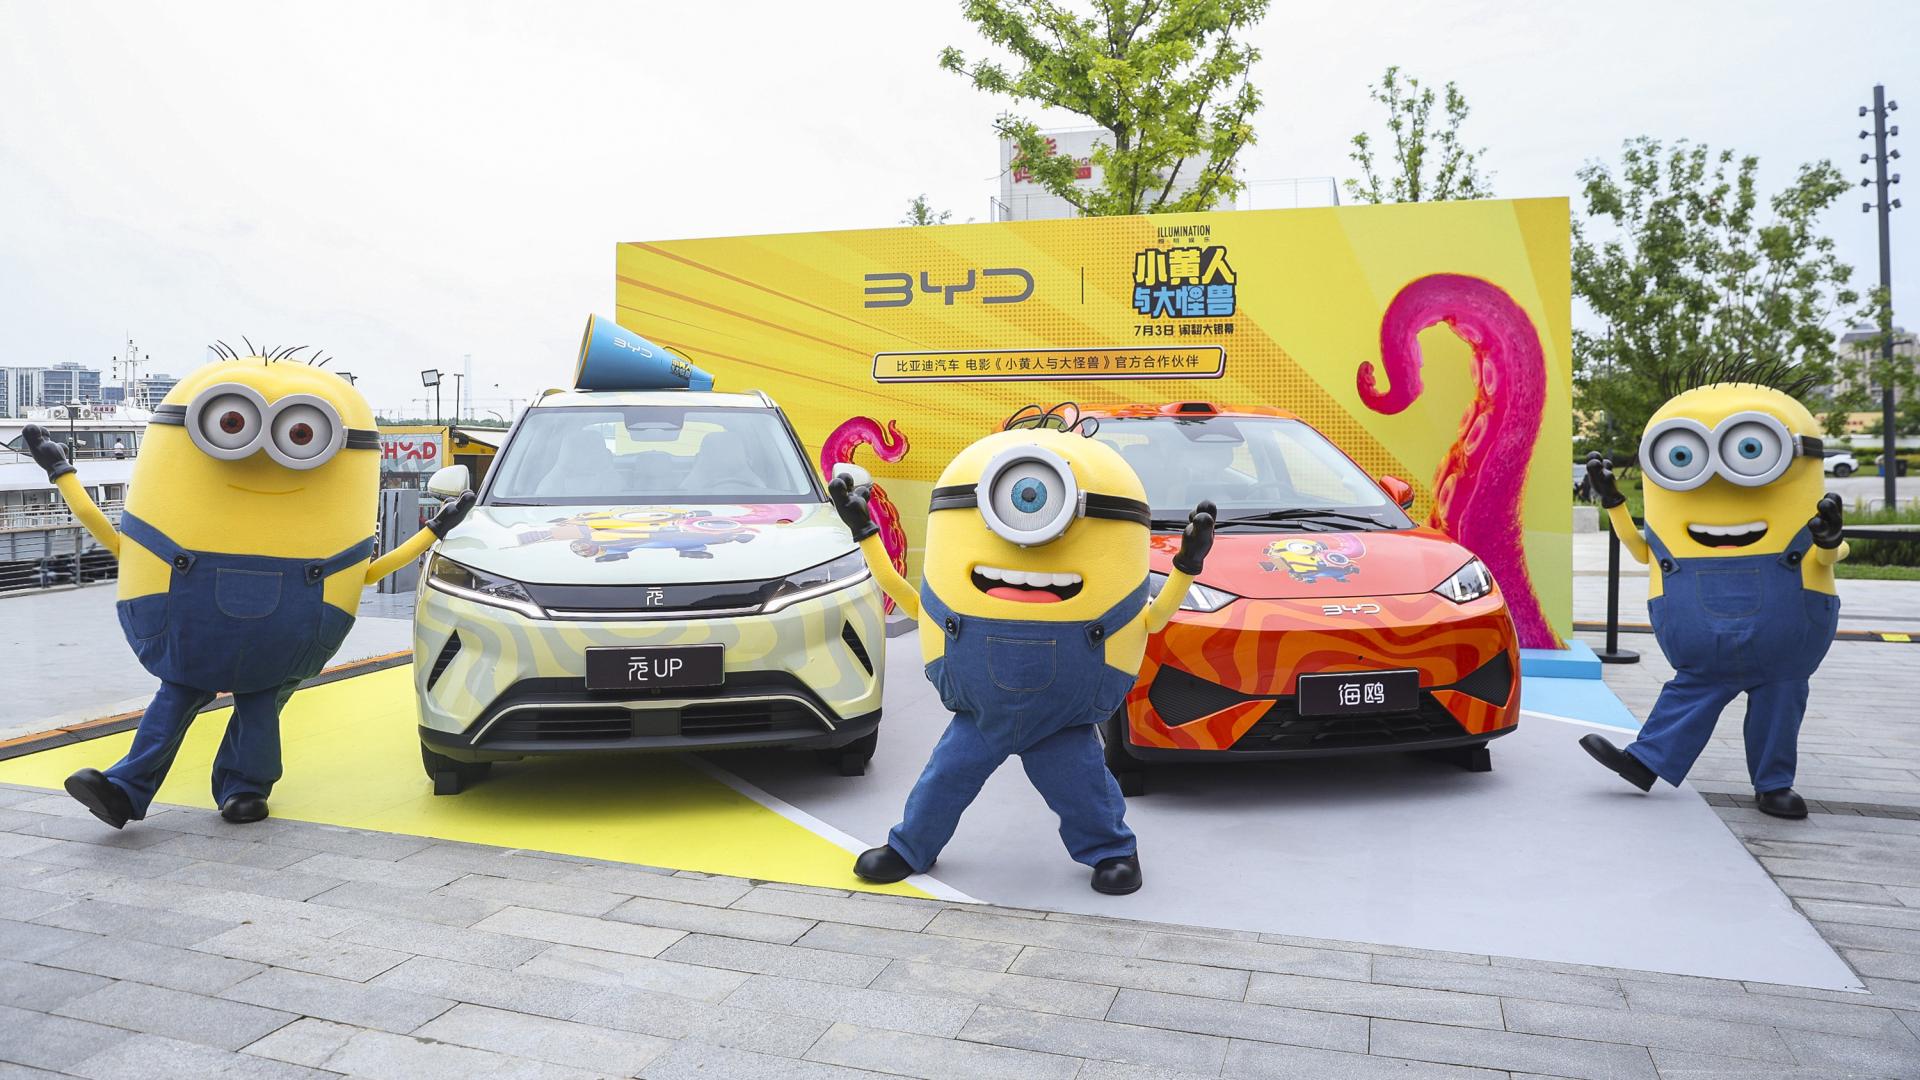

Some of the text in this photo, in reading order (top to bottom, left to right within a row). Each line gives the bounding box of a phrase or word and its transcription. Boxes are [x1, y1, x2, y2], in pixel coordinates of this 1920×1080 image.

[1157, 225, 1211, 238] ILLUMINATION
[1134, 247, 1236, 287] 小黄人
[865, 268, 1035, 308] BYD
[1133, 284, 1235, 317] 与大怪兽
[1134, 325, 1174, 337] 7月3日
[613, 337, 653, 359] BYD
[896, 354, 1200, 373] 比亚迪汽车 电影《小黄人与大怪兽》官方合作伙伴
[646, 586, 664, 606] 元
[1322, 603, 1381, 616] BYD
[628, 656, 683, 681] 元 UP
[1338, 681, 1385, 706] 海鸥
